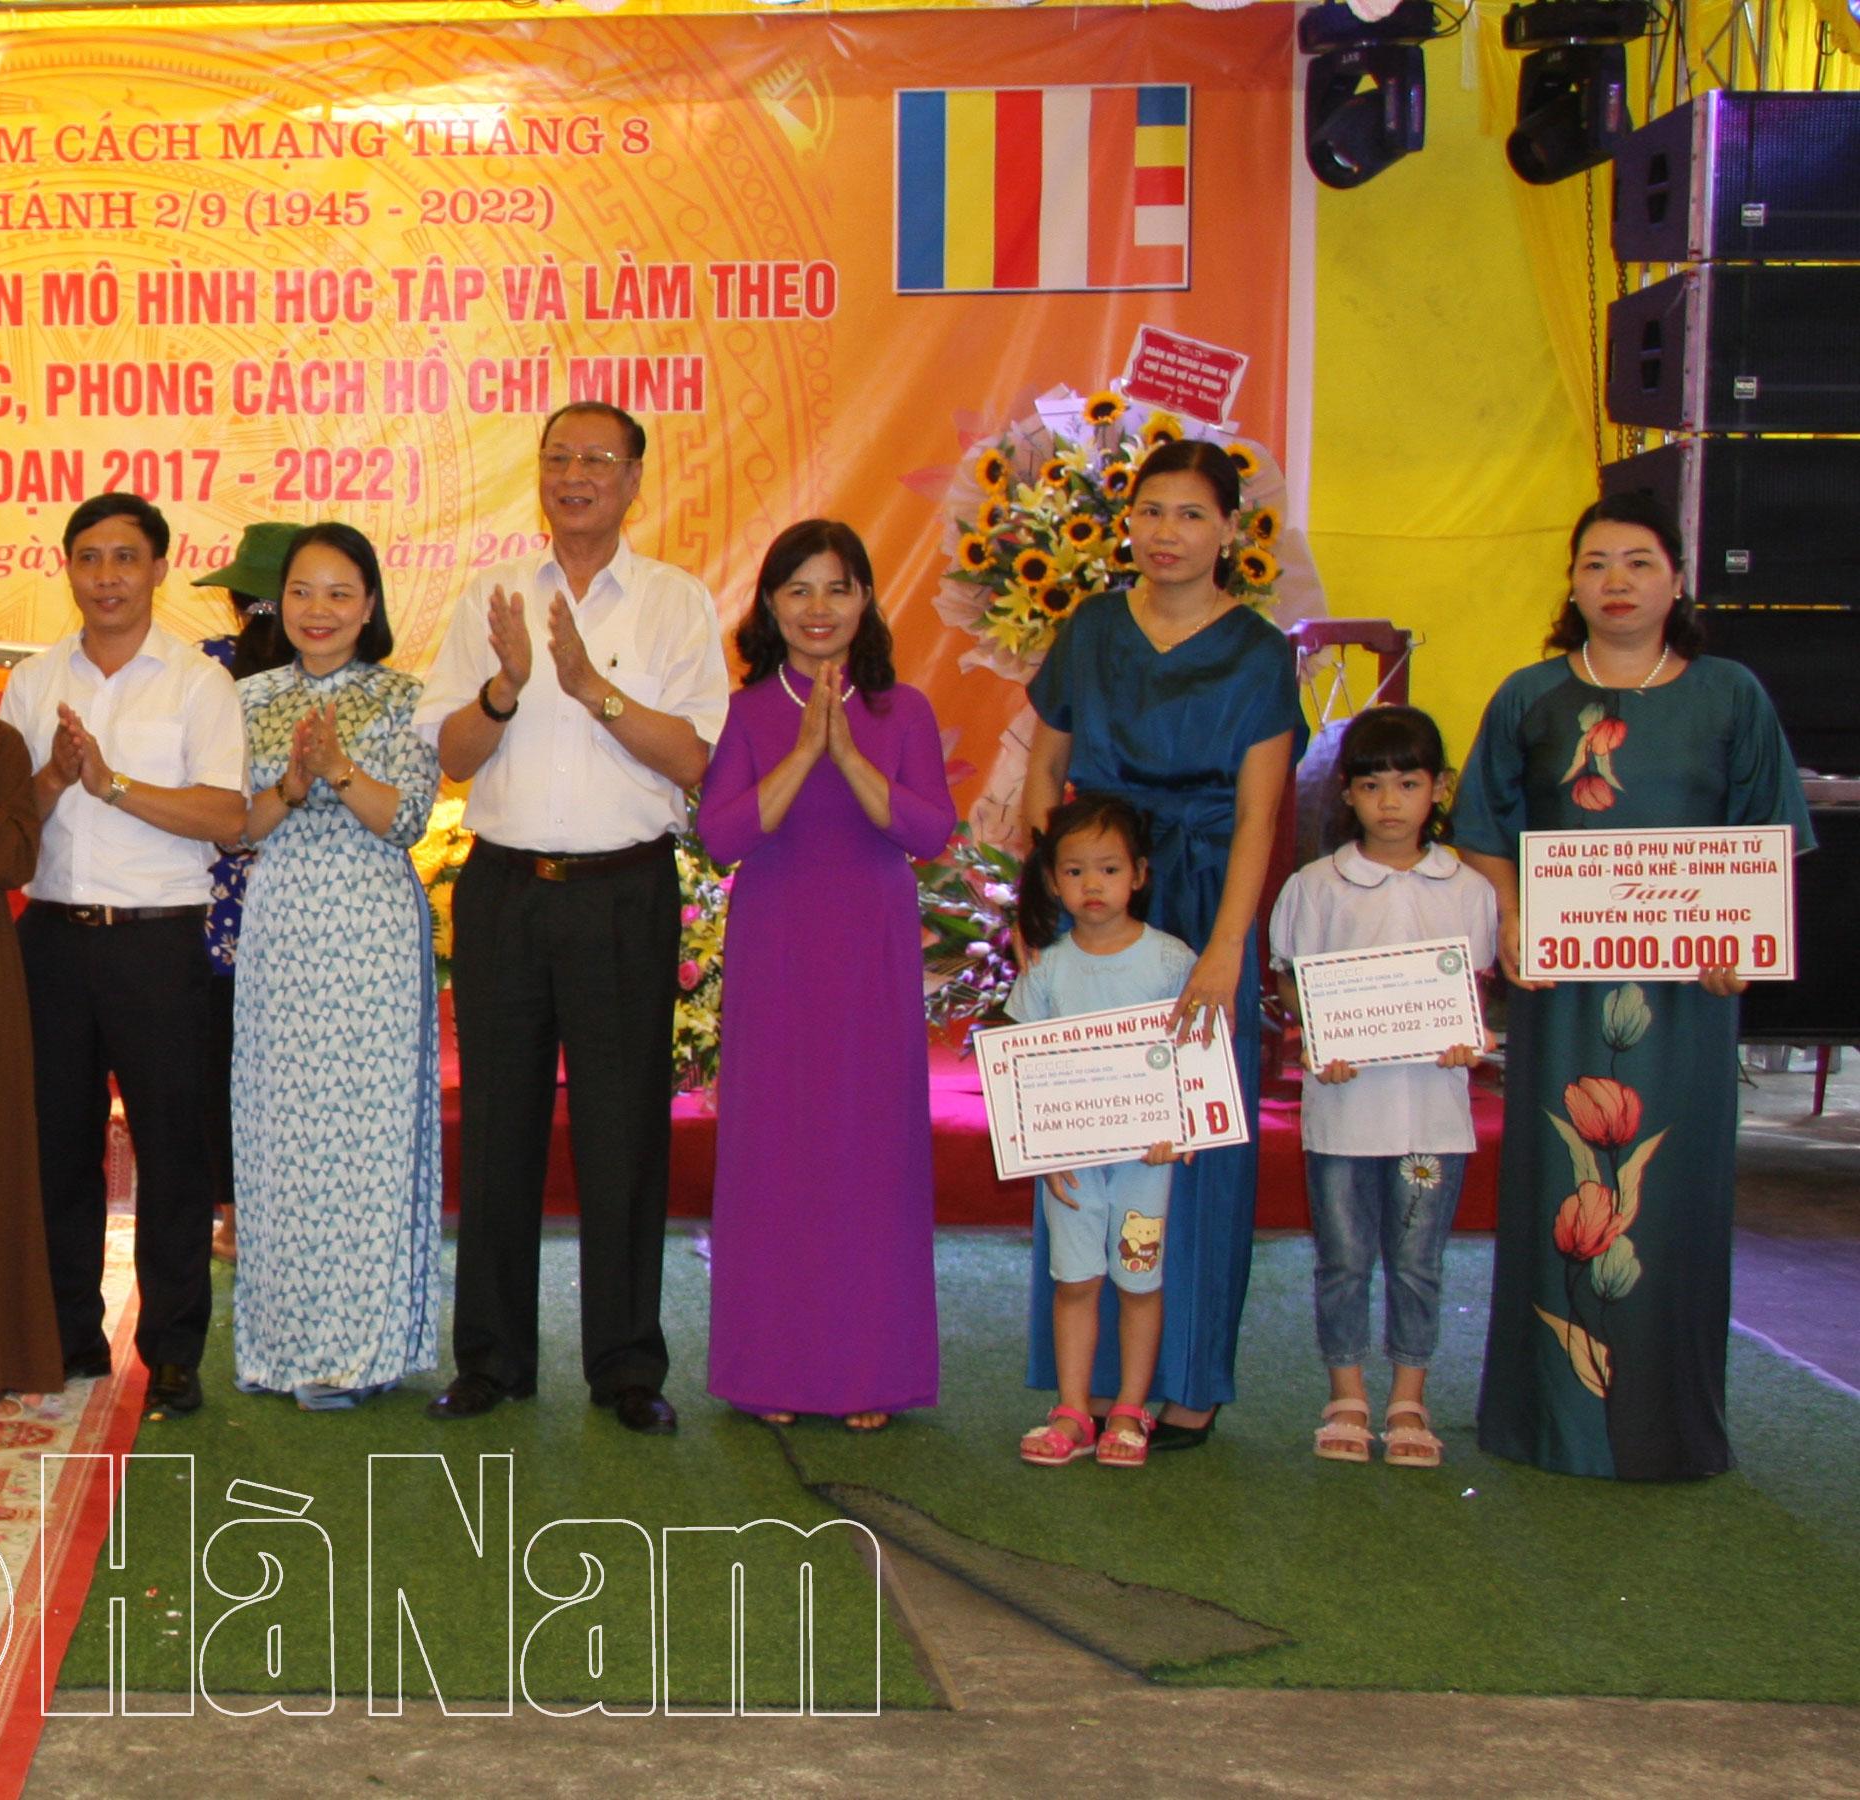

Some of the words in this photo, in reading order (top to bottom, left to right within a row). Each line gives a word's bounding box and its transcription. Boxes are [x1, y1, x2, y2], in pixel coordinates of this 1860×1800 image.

[54, 111, 201, 162] CÁCH
[219, 121, 388, 170] MẠNG
[406, 105, 604, 155] THÁNG
[622, 118, 650, 153] 8
[155, 189, 227, 232] 2/9
[244, 189, 369, 236] (1945
[420, 186, 555, 232] 2022)
[43, 260, 118, 326] MÔ
[139, 259, 255, 324] HÌNH
[275, 269, 373, 335] HỌC
[392, 255, 484, 334] TẬP
[503, 254, 566, 321] VÀ
[585, 253, 691, 319] LÀM
[711, 262, 836, 318] THEO
[47, 363, 213, 417] PHONG
[233, 350, 365, 415] CÁCH
[384, 340, 448, 413] HỒ
[468, 347, 550, 412] CHÍ
[569, 357, 703, 412] MINH
[102, 450, 220, 501] 2017
[374, 534, 457, 568] ăm
[1548, 842, 1577, 857] CÂU
[1582, 843, 1608, 860] LẠC
[1615, 841, 1632, 858] BỘ
[1640, 842, 1668, 858] PHỤ
[1674, 839, 1694, 855] NỮ
[1700, 839, 1737, 856] PHẬT
[1743, 835, 1762, 853] TỬ
[1535, 860, 1572, 877] CHÙA
[1614, 860, 1643, 876] NGÔ
[1649, 860, 1677, 876] KHÊ
[1689, 859, 1725, 875] BÌNH
[1730, 859, 1777, 874] NGHĨA
[1610, 882, 1702, 904] Tặng
[1561, 906, 1627, 924] KHUYẾN
[1633, 911, 1666, 926] HỌC
[1674, 904, 1709, 922] TIỂU
[1717, 909, 1751, 925] HỌC
[1538, 935, 1739, 970] 30.000.000
[1752, 934, 1776, 967] Đ
[1367, 999, 1423, 1017] KHUYẾN
[1427, 998, 1456, 1012] HỌC
[1358, 1023, 1388, 1037] HỌC
[1392, 1020, 1421, 1033] 2022
[1434, 1015, 1463, 1027] 2023
[1075, 1093, 1132, 1112] KHUYẾN
[1135, 1092, 1164, 1107] HỌC
[1066, 1116, 1095, 1132] HỌC
[1100, 1113, 1129, 1126] 2022
[1141, 1110, 1170, 1123] 2023
[1205, 1101, 1230, 1135] Đ
